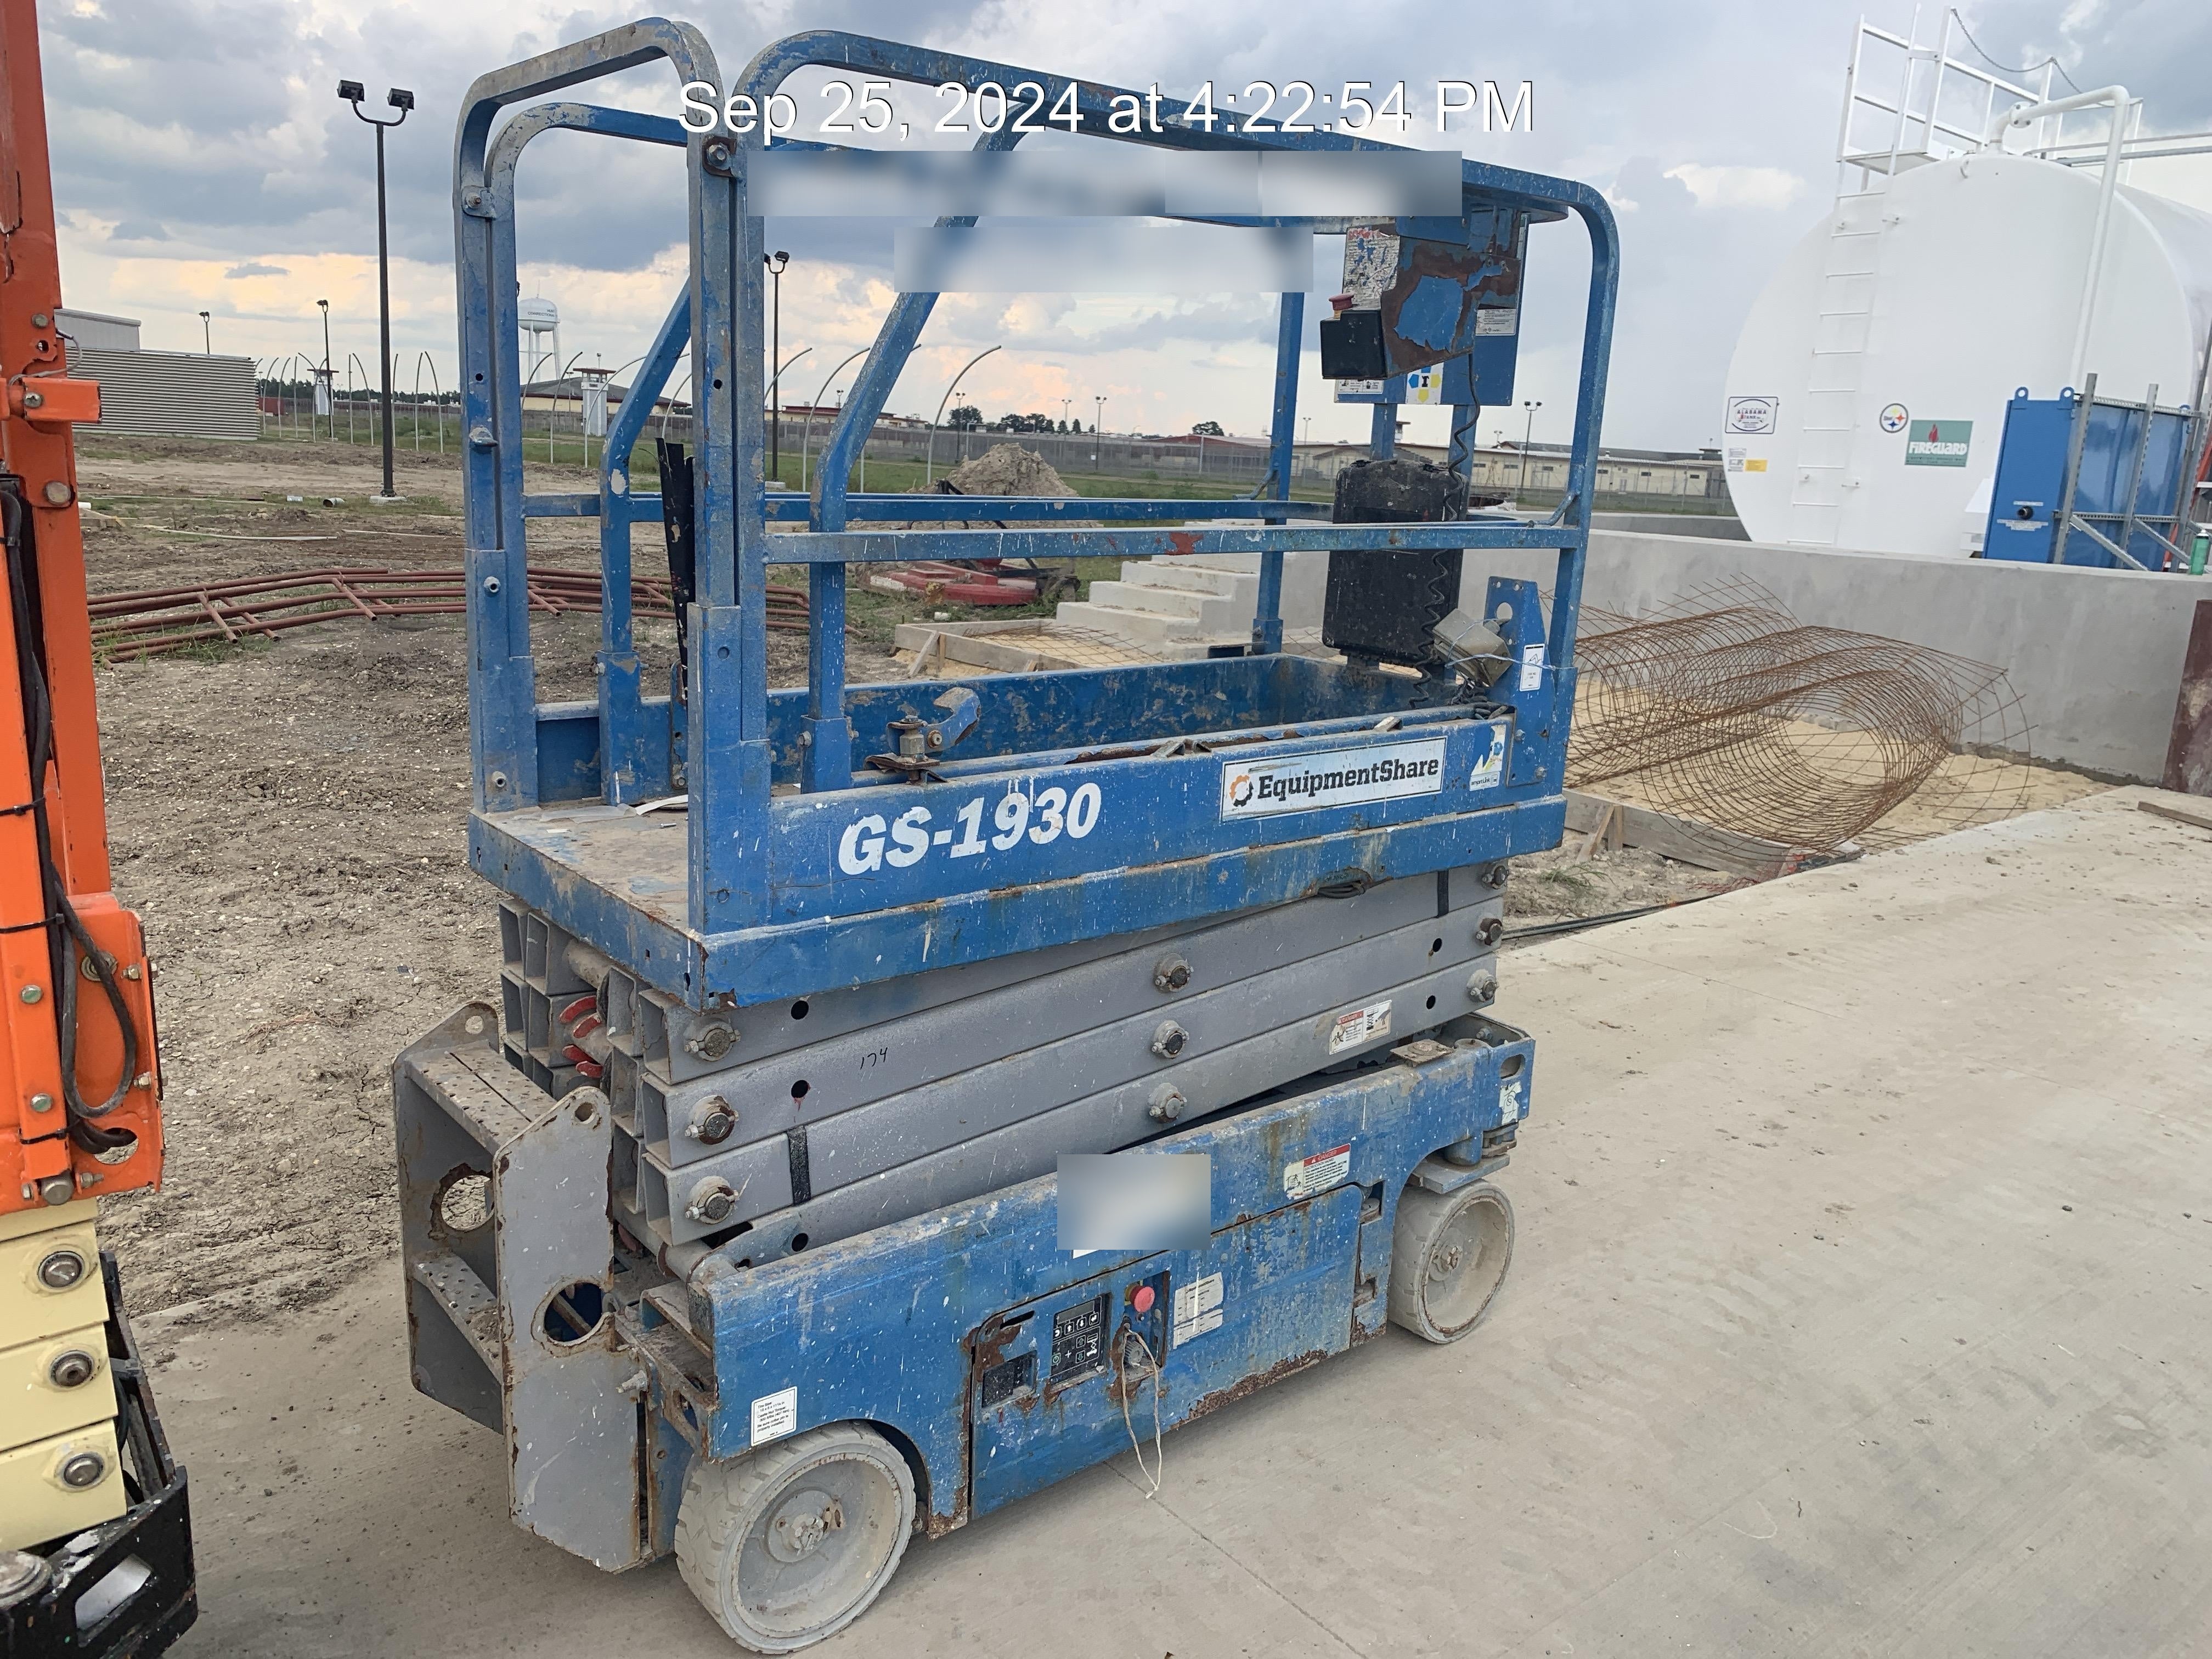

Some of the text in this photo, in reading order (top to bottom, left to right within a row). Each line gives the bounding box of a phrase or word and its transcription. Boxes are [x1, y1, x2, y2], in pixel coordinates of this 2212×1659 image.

[1256, 757, 1440, 802] EquipmentShare
[838, 782, 1102, 876] GS-1930
[1318, 1150, 1337, 1160] DANGER
